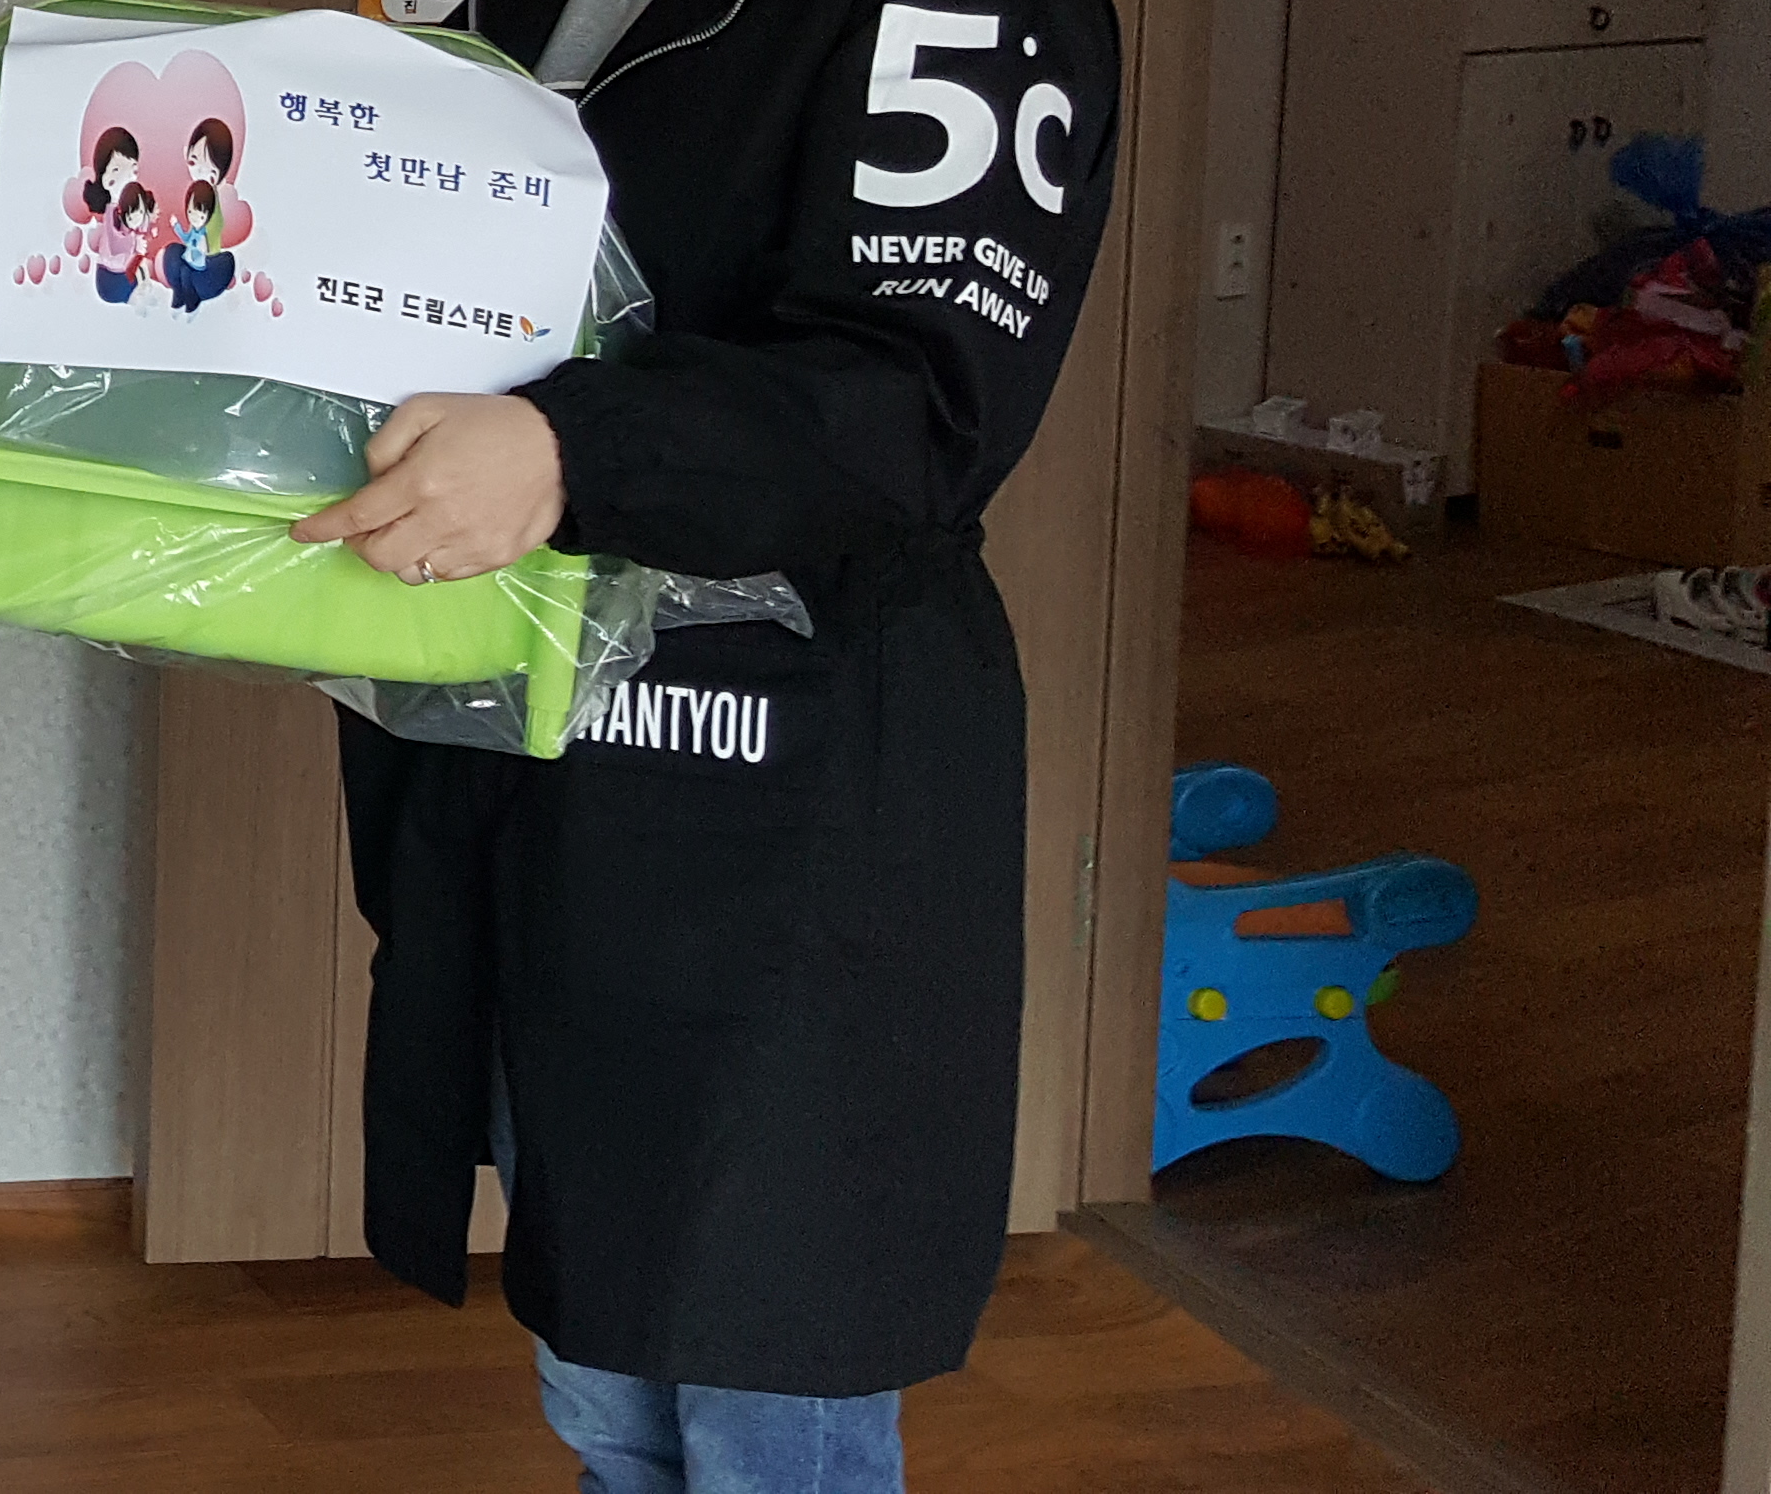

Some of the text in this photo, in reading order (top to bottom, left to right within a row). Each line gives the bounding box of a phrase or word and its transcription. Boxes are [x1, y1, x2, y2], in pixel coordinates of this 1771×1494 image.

[404, 0, 417, 14] 집
[279, 91, 381, 132] 행복한
[363, 151, 551, 208] 첫만남 준비
[851, 235, 1050, 306] NEVER GIVE UP
[316, 276, 514, 339] 진도군 드림스타트
[872, 277, 1032, 340] RUN AWAY
